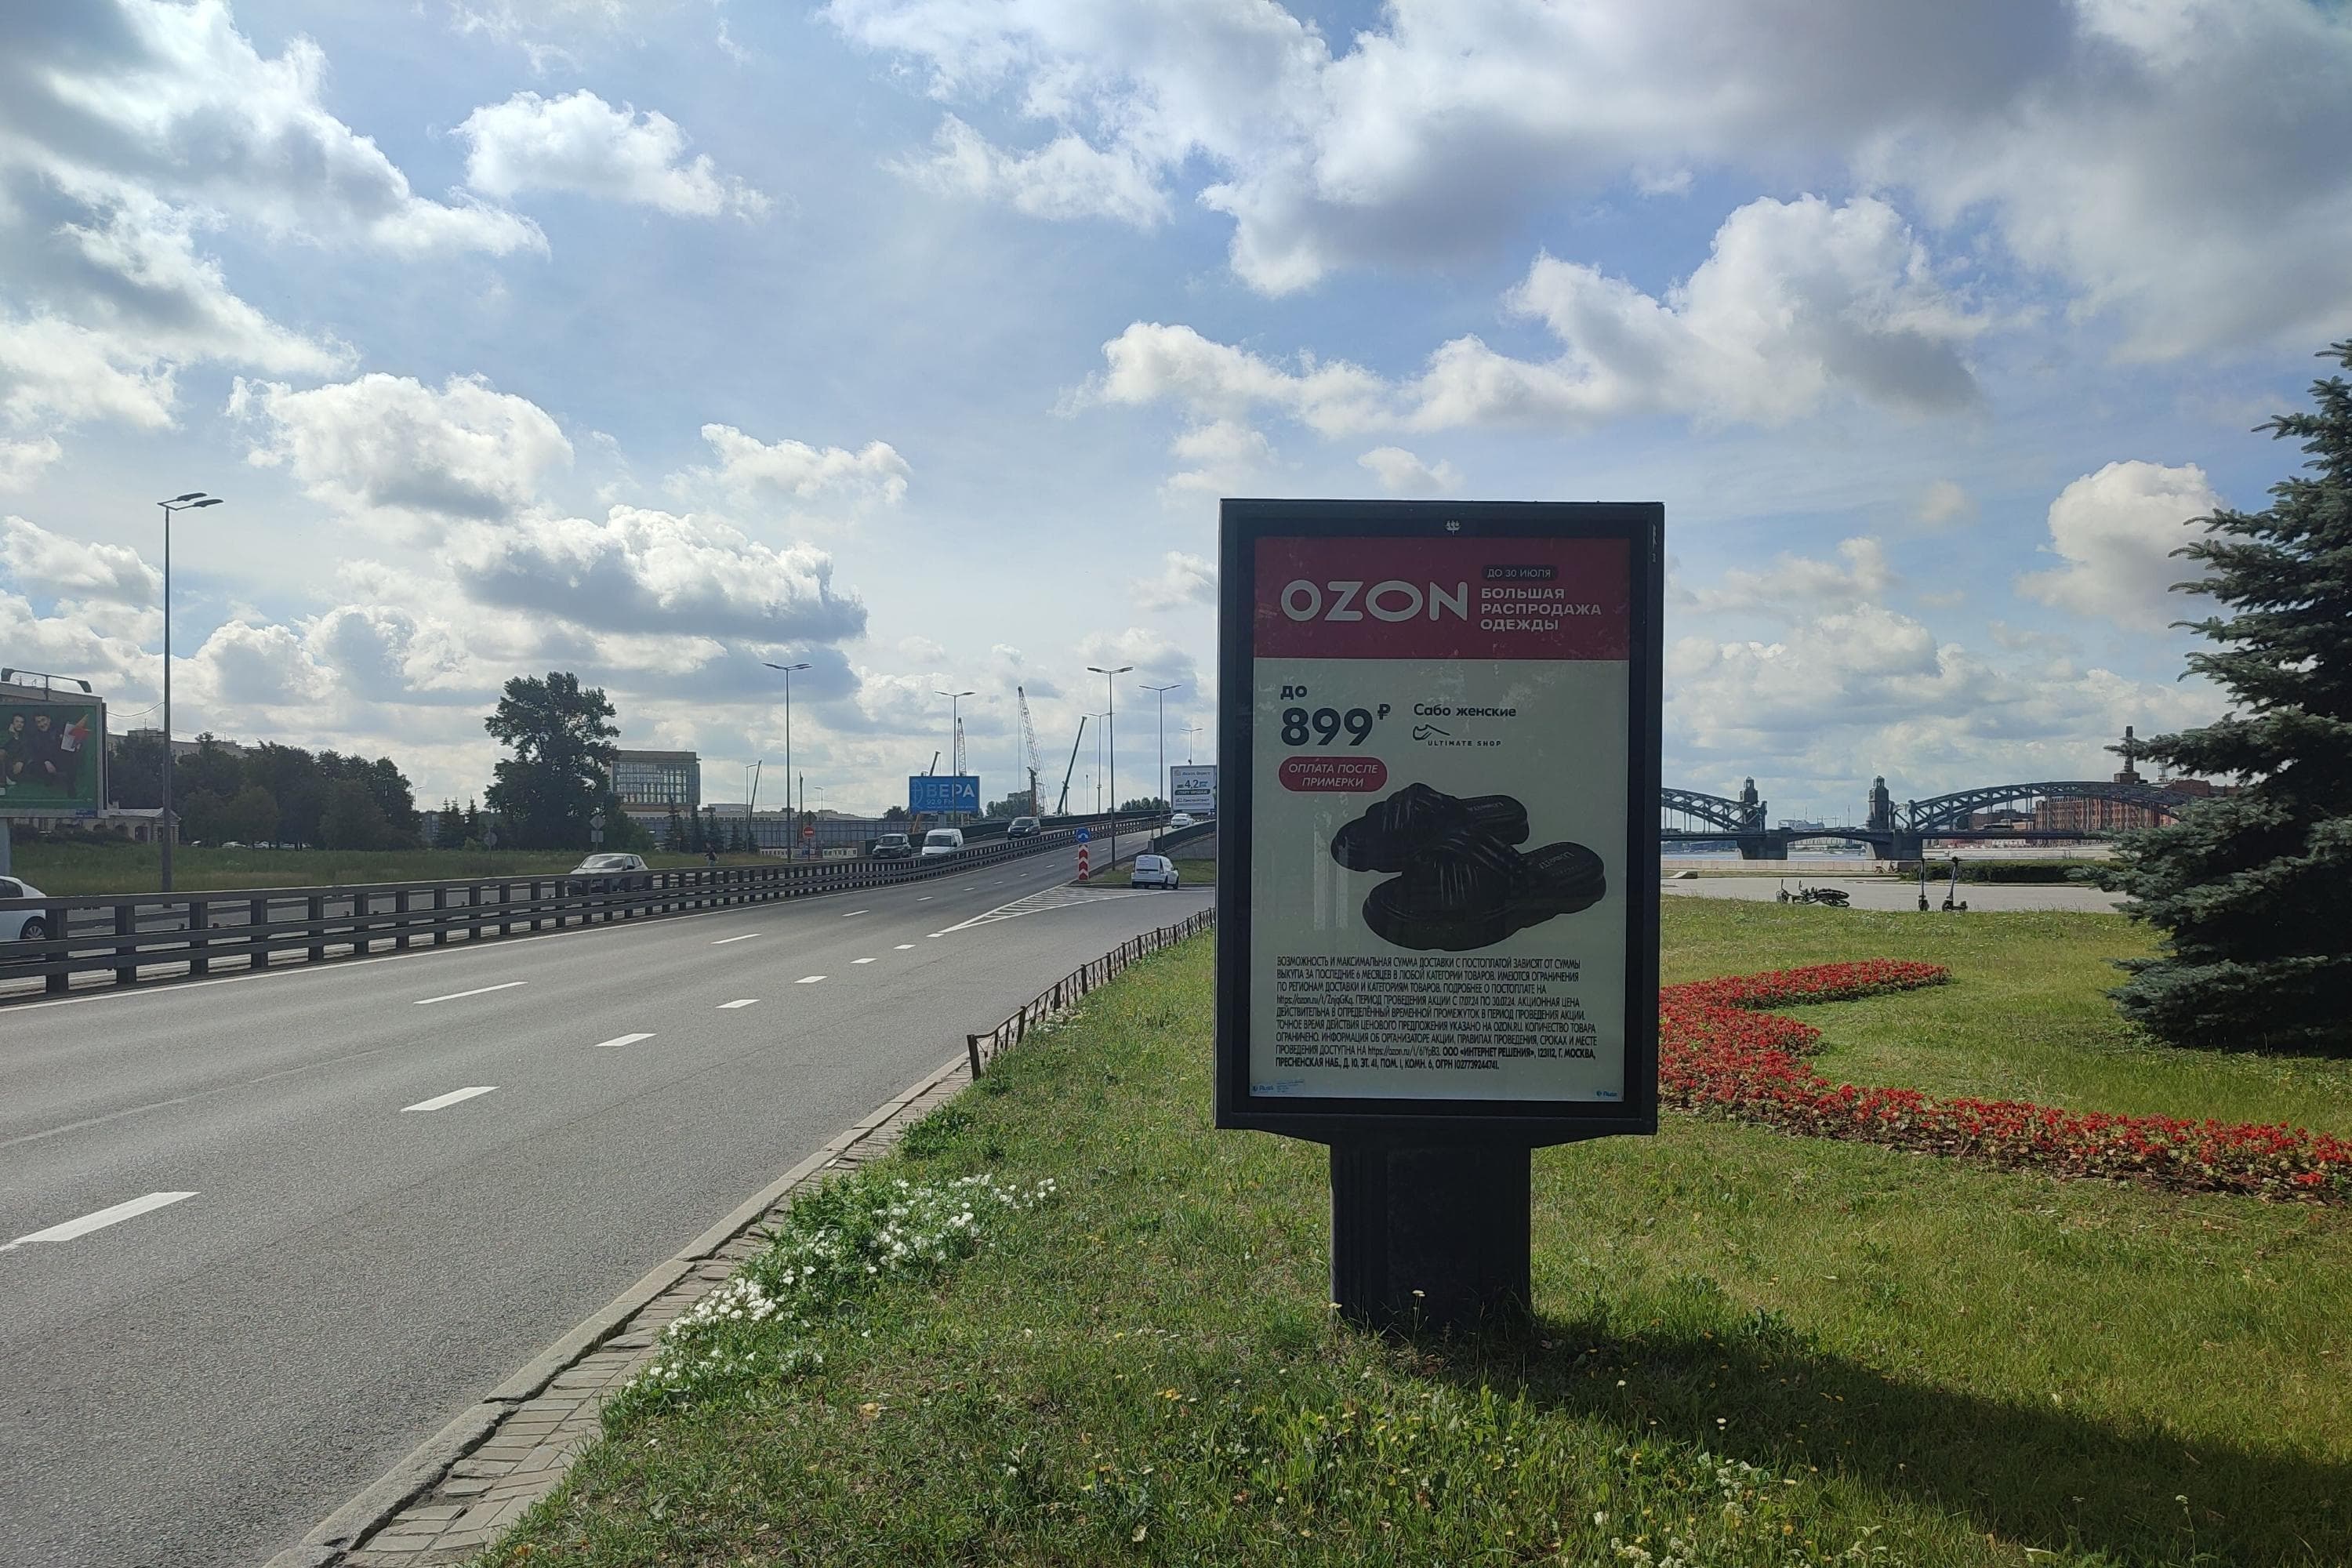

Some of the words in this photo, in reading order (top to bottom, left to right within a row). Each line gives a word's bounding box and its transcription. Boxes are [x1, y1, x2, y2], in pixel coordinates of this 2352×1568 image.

[1487, 569, 1502, 578] ДО
[1519, 569, 1551, 578] ИЮЛЯ
[1481, 588, 1565, 599] БОЛЬШАЯ
[1280, 579, 1468, 622] OZON
[1481, 604, 1602, 616] РАСПРОДАЖА
[1480, 619, 1559, 632] ОДЕЖДЫ
[1414, 703, 1451, 717] Сабо
[1455, 707, 1517, 717] женские
[1288, 764, 1334, 774] ОПЛАТА
[1337, 764, 1378, 774] ПОСЛЕ
[1301, 777, 1364, 788] ПРИМЕРКИ
[927, 784, 975, 797] ВЕРА
[1276, 956, 1328, 966] ВОЗМОЖНОСТЬ
[1330, 956, 1336, 966] И
[1336, 956, 1392, 966] МАКСИМАЛЬНАЯ
[1392, 957, 1417, 967] СУММА
[1419, 957, 1454, 968] ДОСТАВКИ
[1455, 957, 1460, 967] С
[1461, 956, 1512, 967] ПОСТОПЛАТОЙ
[1512, 958, 1543, 967] ЗАВИСЯТ
[1544, 958, 1552, 967] ОТ
[1554, 958, 1580, 967] СУММЫ
[1276, 968, 1303, 978] ВЫКУПА
[1305, 969, 1314, 978] ЗА
[1315, 969, 1355, 980] ПОСЛЕДНИЕ
[1356, 969, 1360, 978] 6
[1361, 969, 1391, 980] МЕСЯЦЕВ
[1392, 970, 1397, 978] В
[1399, 968, 1424, 979] ЛЮБОЙ
[1426, 970, 1463, 979] КАТЕГОРИИ
[1497, 971, 1530, 980] ИМЕЮТСЯ
[1531, 971, 1579, 980] ОГРАНИЧЕНИЯ
[1276, 982, 1287, 991] ПО
[1288, 982, 1323, 991] РЕГИОНАМ
[1325, 982, 1359, 993] ДОСТАВКИ
[1361, 982, 1366, 992] И
[1367, 982, 1408, 992] КАТЕГОРИЯМ
[1443, 983, 1482, 994] ПОДРОБНЕЕ
[1483, 983, 1490, 993] О
[1491, 983, 1535, 993] ПОСТОПЛАТЕ
[1536, 984, 1546, 993] НА
[1355, 995, 1382, 1005] ПЕРИОД
[1383, 995, 1426, 1006] ПРОВЕДЕНИЯ
[1427, 996, 1450, 1006] АКЦИИ
[1452, 996, 1457, 1005] С
[1480, 996, 1490, 1005] ПО
[1517, 996, 1559, 1007] АКЦИОННАЯ
[1562, 997, 1579, 1007] ЦЕНА
[1276, 1006, 1330, 1018] ДЕЙСТВИТЕЛЬНА
[1331, 1007, 1336, 1017] В
[1338, 1006, 1389, 1018] ОПРЕДЕЛЁННЫЙ
[1391, 1007, 1432, 1018] ВРЕМЕННОЙ
[1433, 1008, 1480, 1018] ПРОМЕЖУТОК
[1482, 1009, 1485, 1018] В
[1486, 1009, 1513, 1020] ПЕРИОД
[1515, 1009, 1559, 1020] ПРОВЕДЕНИЯ
[1276, 1019, 1301, 1029] ТОЧНОЕ
[1303, 1019, 1324, 1029] ВРЕМЯ
[1326, 1018, 1359, 1030] ДЕЙСТВИЯ
[1360, 1020, 1397, 1030] ЦЕНОВОГО
[1398, 1020, 1447, 1031] ПРЕДЛОЖЕНИЯ
[1449, 1021, 1481, 1030] УКАЗАНО
[1482, 1021, 1491, 1030] НА
[1524, 1022, 1568, 1031] КОЛИЧЕСТВО
[1570, 1022, 1596, 1031] ТОВАРА
[1321, 1033, 1368, 1044] ИНФОРМАЦИЯ
[1370, 1033, 1380, 1042] ОБ
[1381, 1033, 1429, 1043] ОРГАНИЗАТОРЕ
[1457, 1034, 1492, 1043] ПРАВИЛАХ
[1494, 1034, 1538, 1045] ПРОВЕДЕНИЯ,
[1540, 1035, 1566, 1044] СРОКАХ
[1568, 1035, 1573, 1044] И
[1575, 1035, 1597, 1044] МЕСТЕ
[1275, 1044, 1317, 1055] ПРОВЕДЕНИЯ
[1319, 1045, 1355, 1055] ДОСТУПНА
[1356, 1045, 1366, 1054] НА
[1443, 1047, 1458, 1055] ООО
[1275, 1058, 1323, 1067] ПРЕСНЕНСКАЯ
[1435, 1059, 1453, 1068] ОГРН
